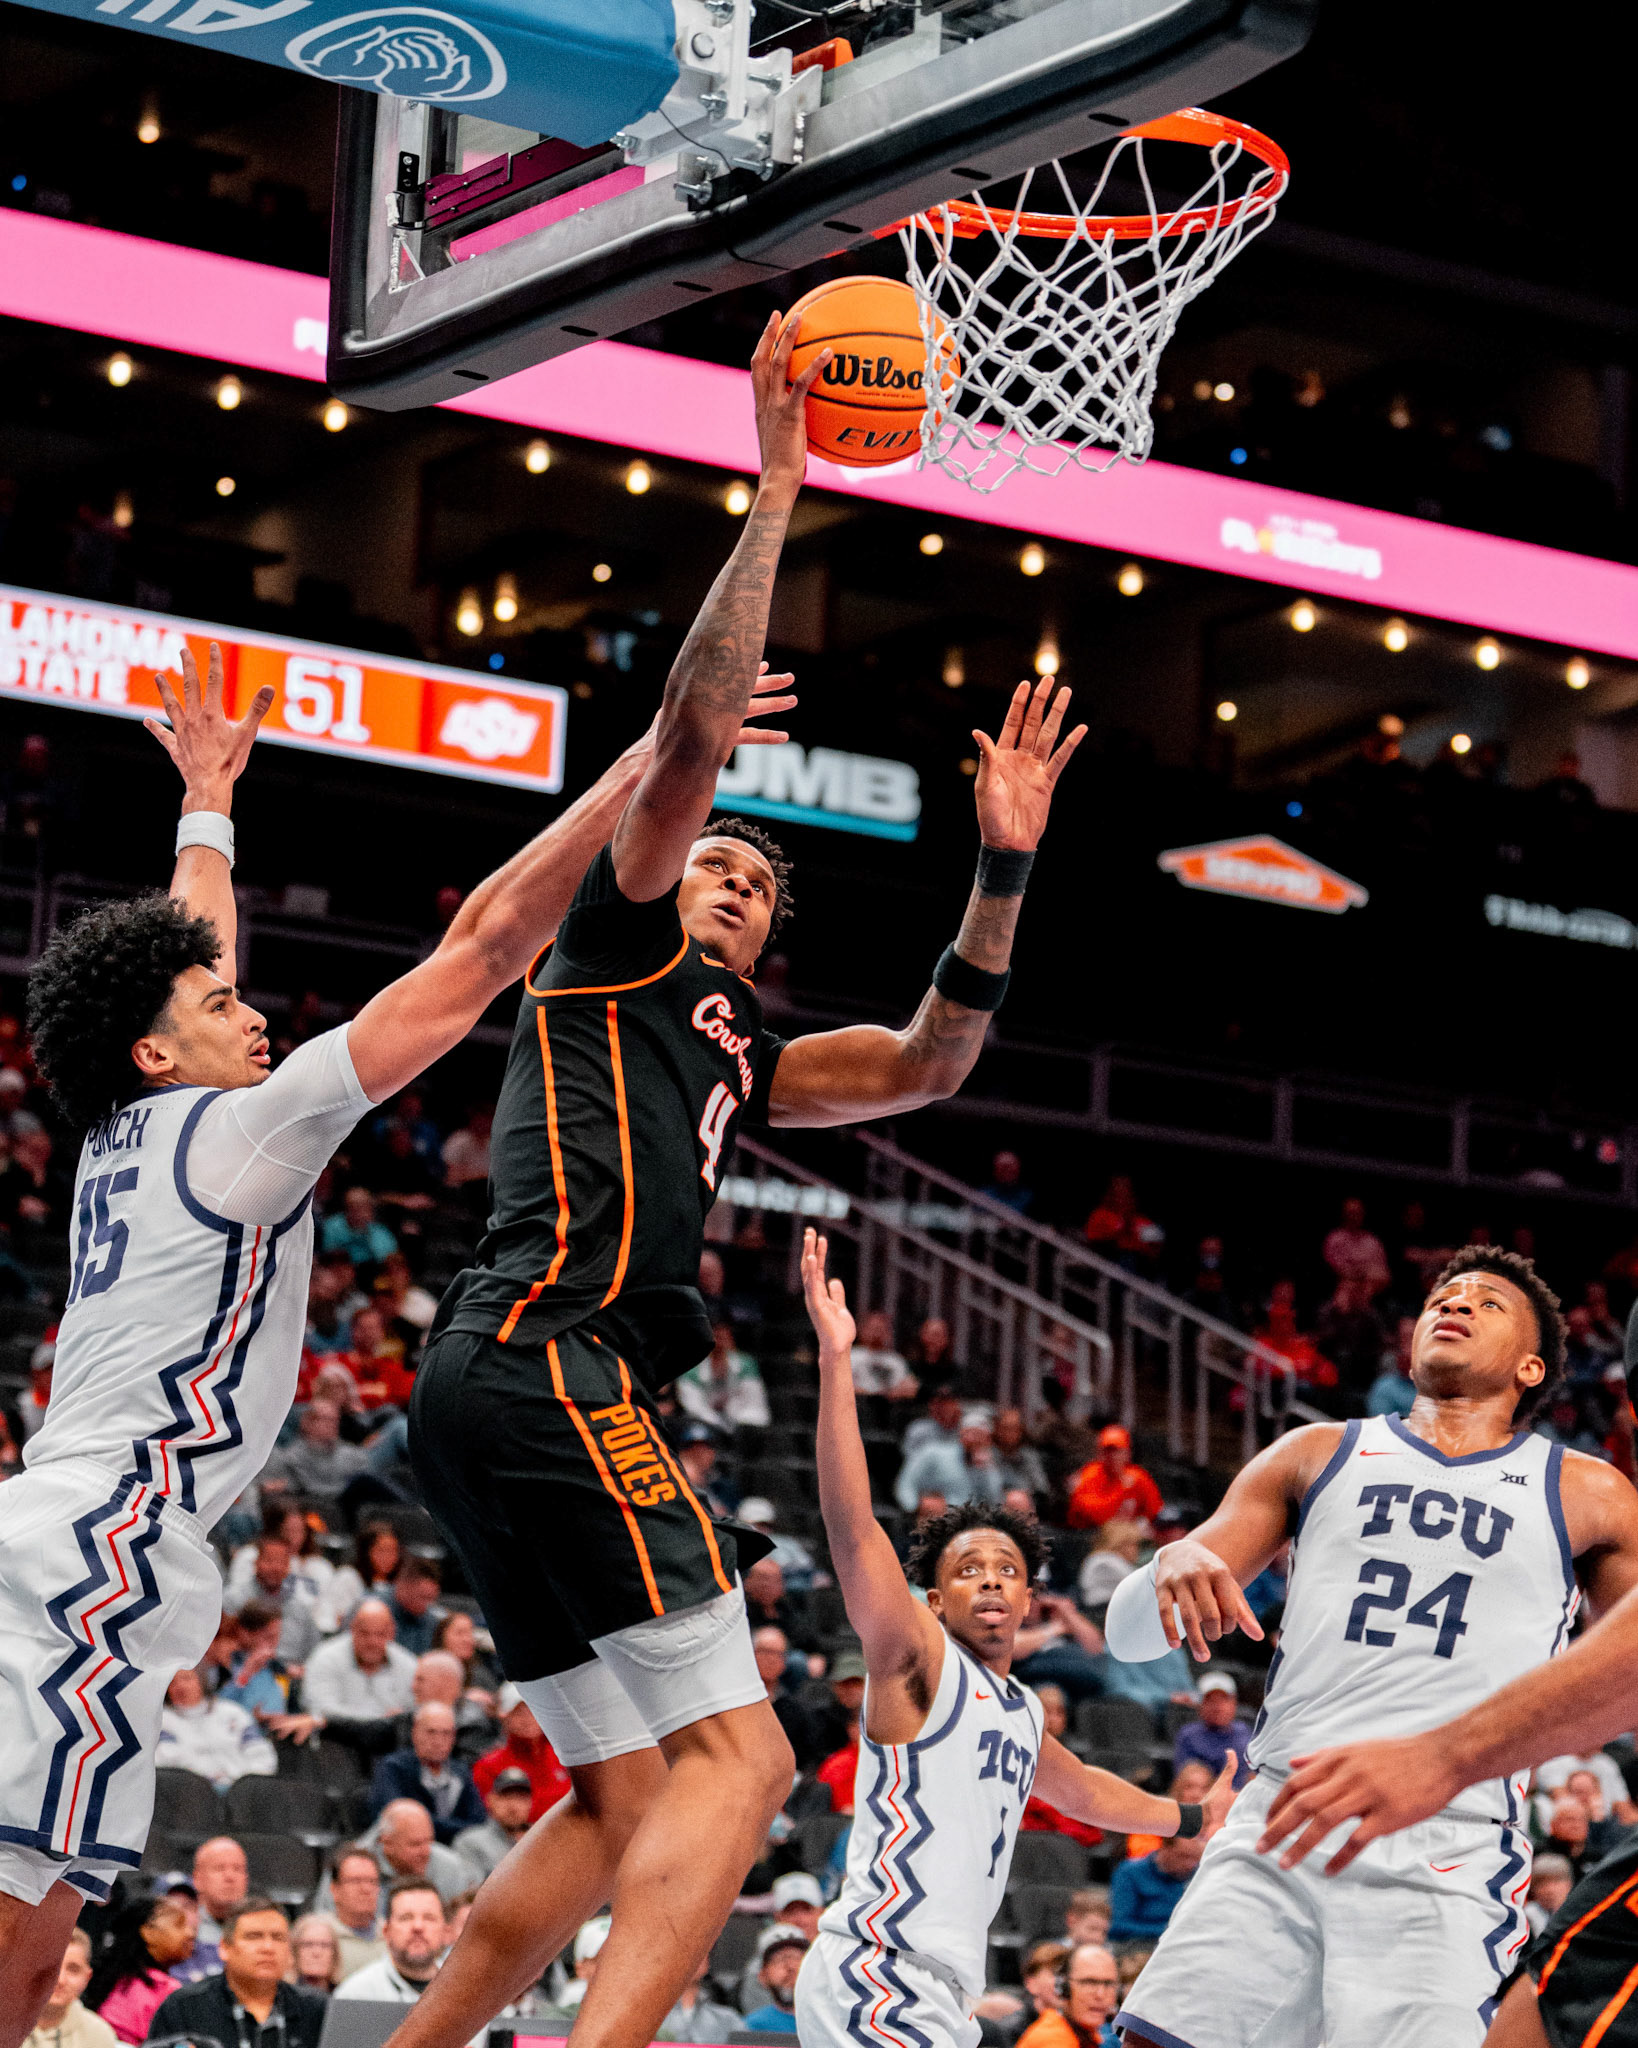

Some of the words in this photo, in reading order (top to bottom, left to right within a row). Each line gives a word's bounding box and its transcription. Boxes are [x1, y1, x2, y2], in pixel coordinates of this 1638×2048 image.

[823, 354, 924, 391] Wilso
[836, 427, 914, 449] EVO
[284, 655, 370, 743] 51
[698, 1081, 740, 1192] 4
[65, 1166, 140, 1306] 15
[589, 1402, 677, 1507] POKES
[1356, 1483, 1515, 1560] TCU
[1343, 1557, 1474, 1660] 24
[977, 1729, 1037, 1806] TCU
[987, 1806, 1009, 1879] 1
